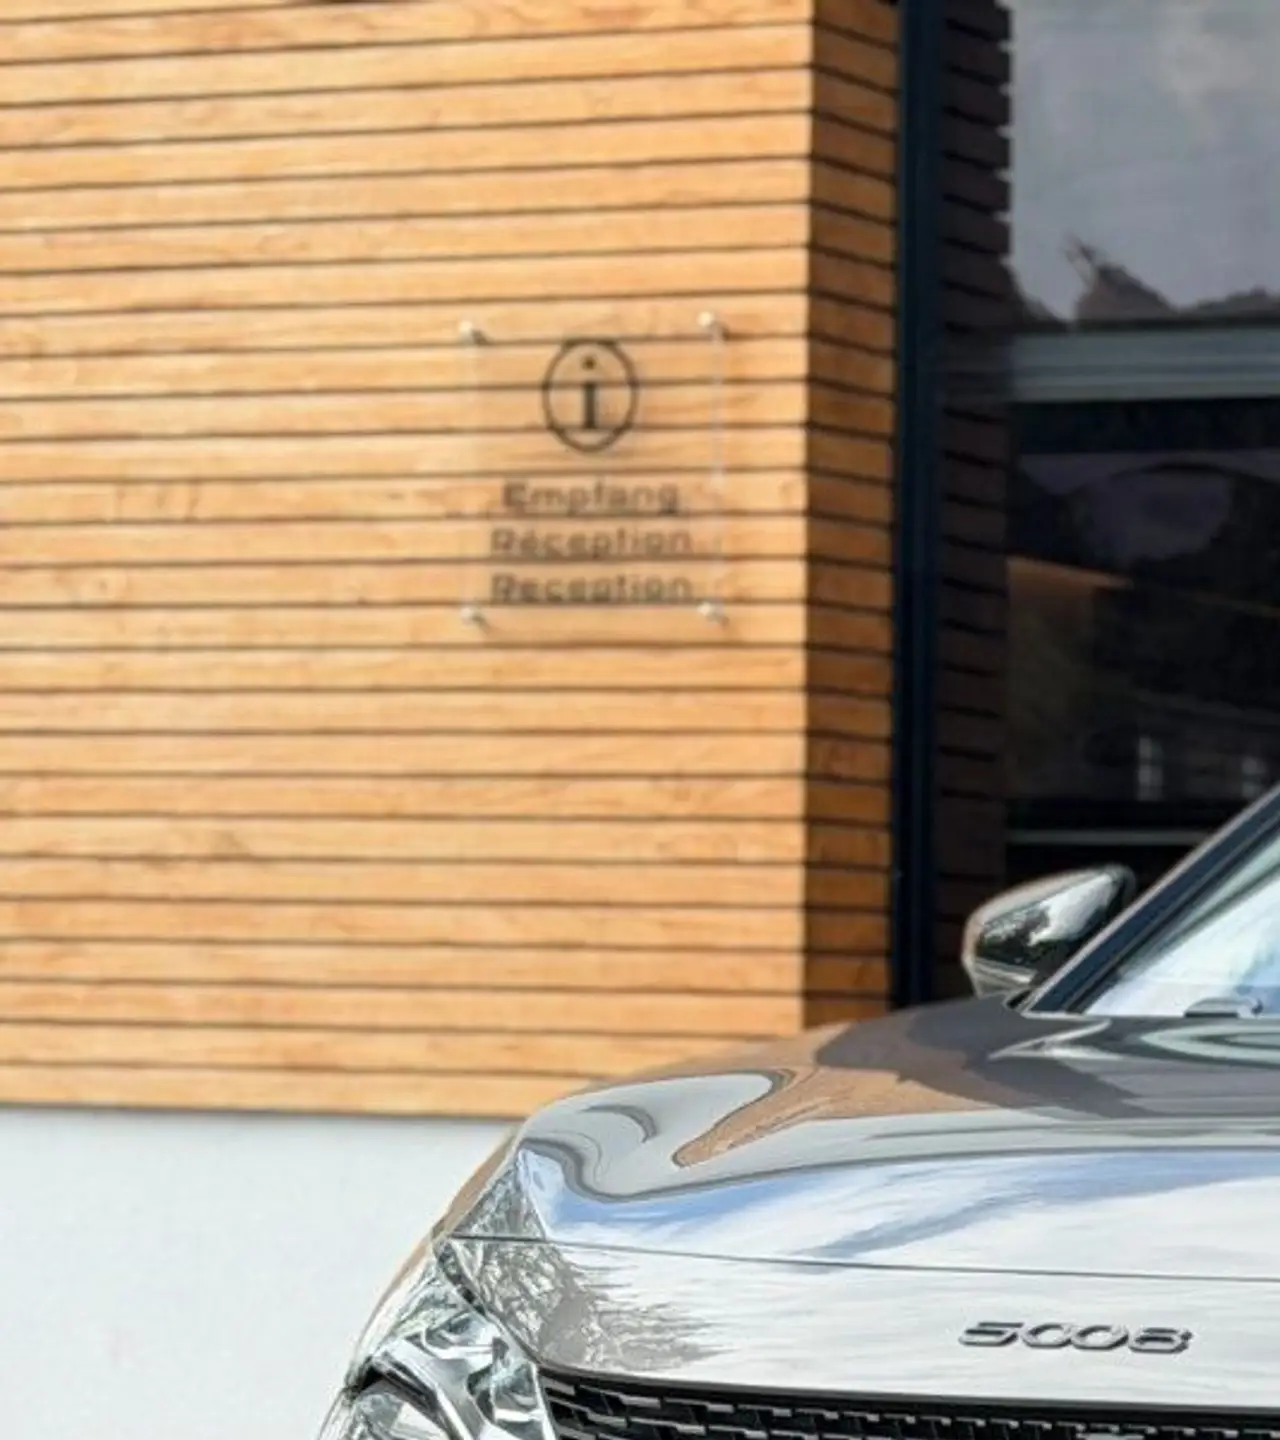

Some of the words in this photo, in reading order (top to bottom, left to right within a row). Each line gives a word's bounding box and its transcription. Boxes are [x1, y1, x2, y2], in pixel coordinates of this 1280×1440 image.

[503, 480, 680, 515] Empfang
[491, 526, 693, 559] Réception
[491, 573, 693, 603] Reception
[959, 1320, 1194, 1354] 5008
